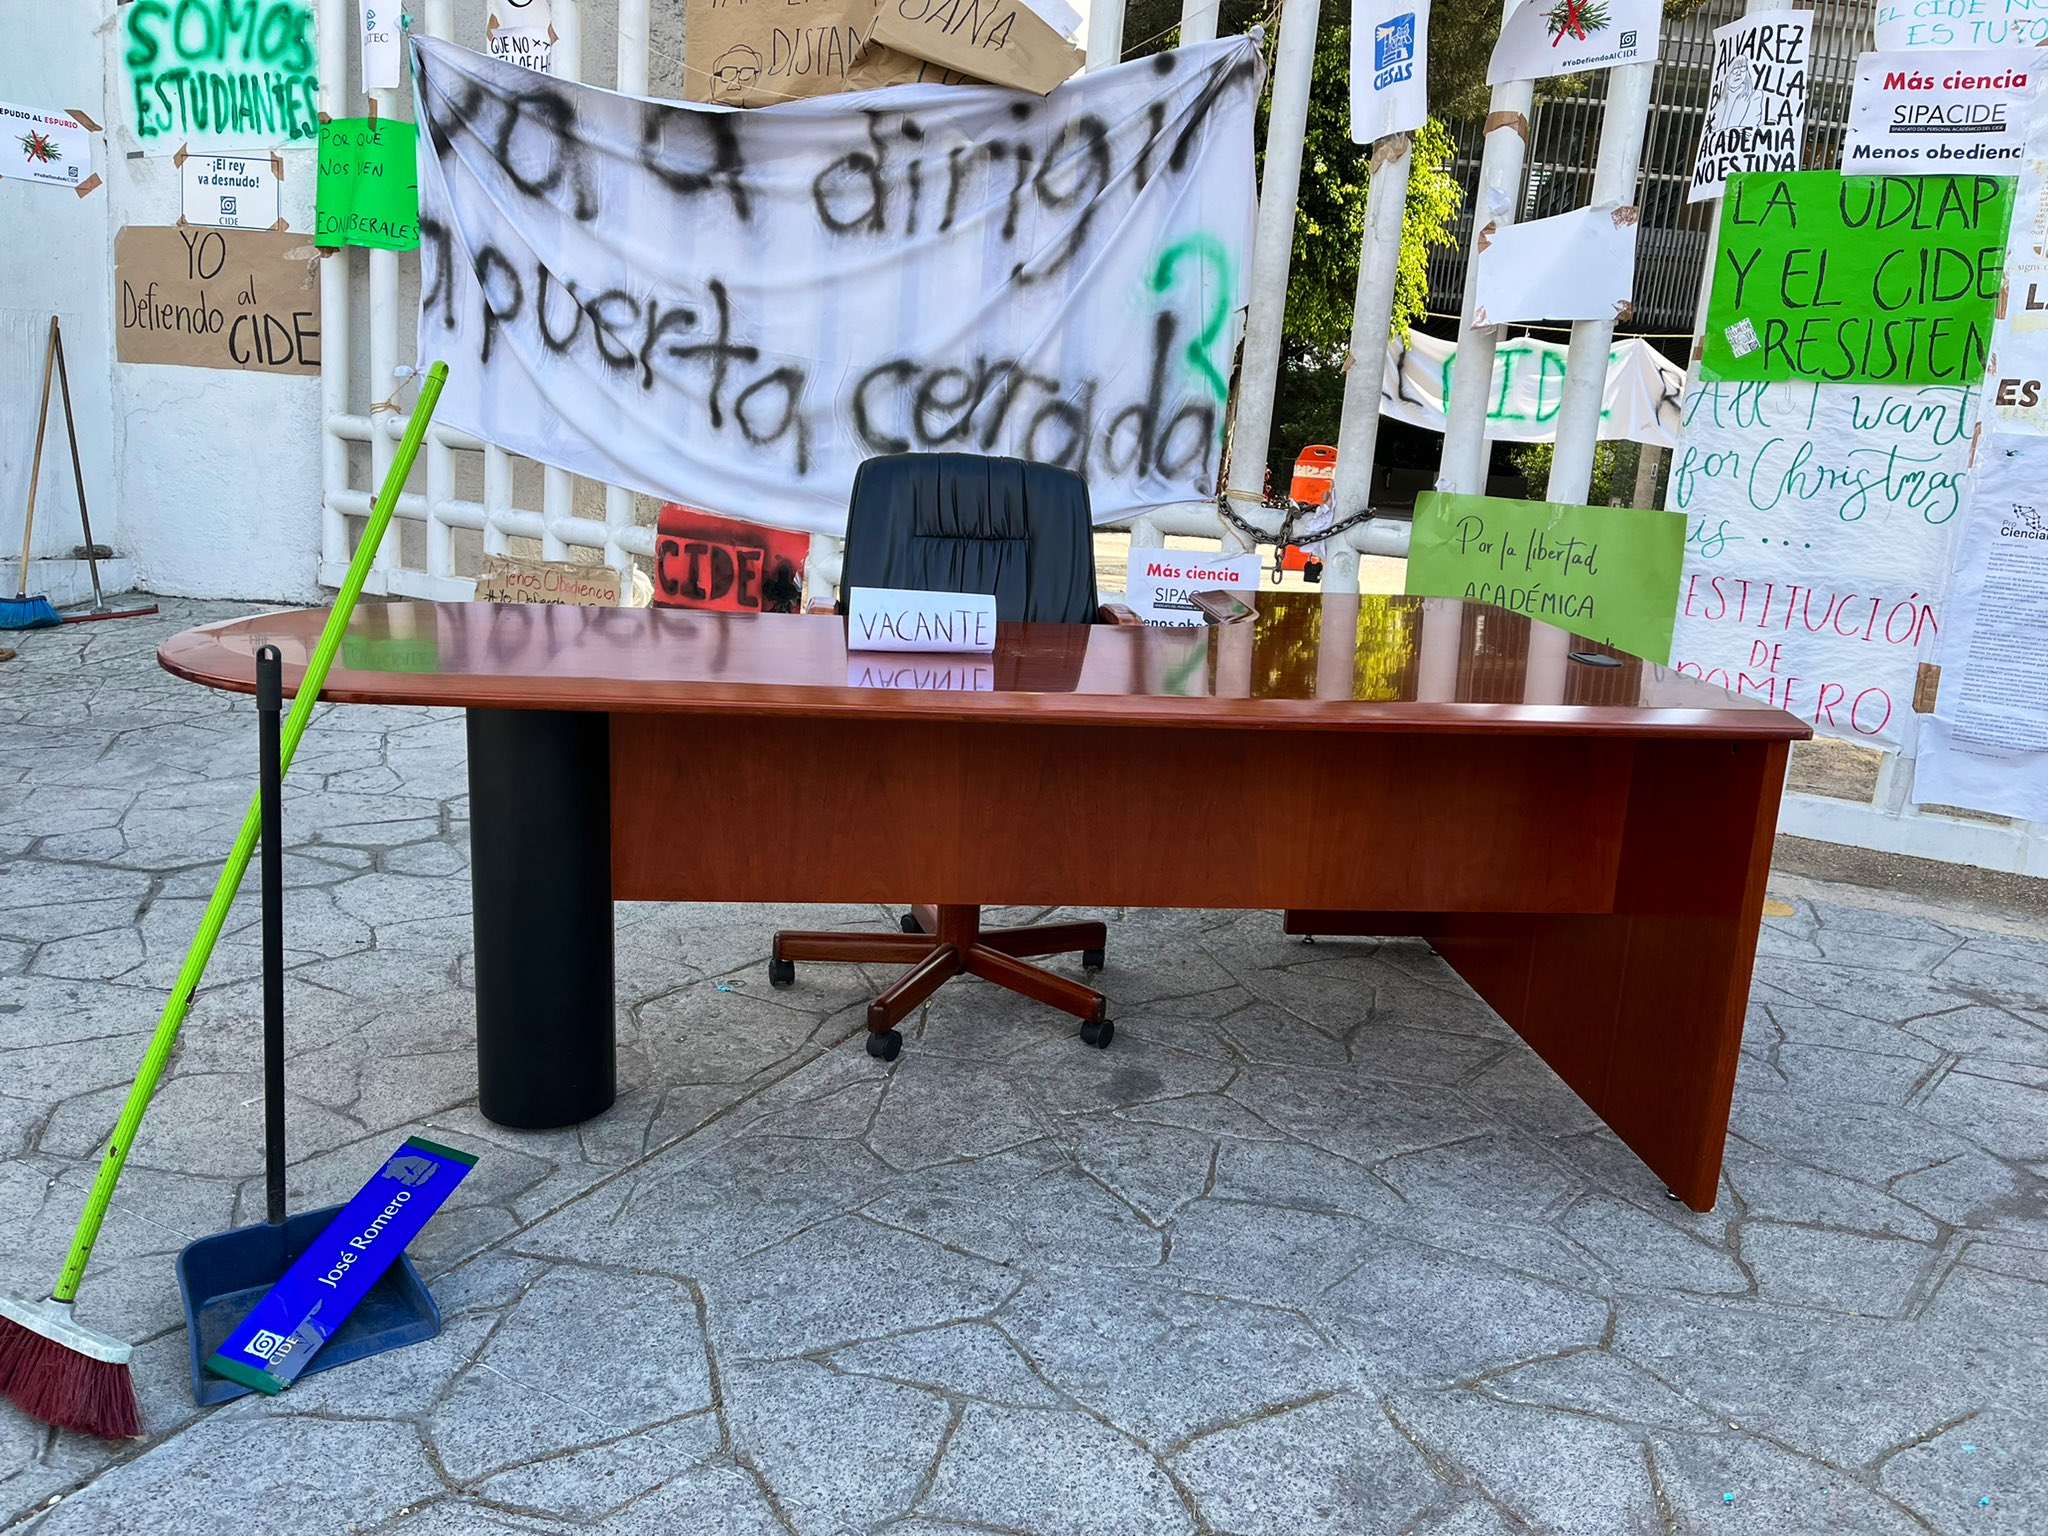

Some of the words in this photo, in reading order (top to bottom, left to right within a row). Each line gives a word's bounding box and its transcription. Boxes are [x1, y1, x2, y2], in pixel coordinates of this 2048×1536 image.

[1878, 7, 1905, 26] EL
[127, 0, 313, 72] SOMOS
[512, 36, 530, 54] NO
[1906, 23, 1955, 46] ES
[1883, 70, 1935, 91] Más
[1946, 68, 2028, 91] ciencia
[32, 114, 43, 122] AL
[44, 116, 79, 129] ESPURIO
[1893, 103, 2008, 124] SIPACIDE
[320, 127, 350, 147] POR
[1698, 127, 1796, 162] ACADEMIA
[1852, 145, 1919, 160] Menos
[198, 175, 209, 185] va
[211, 173, 260, 189] desnudo!
[229, 161, 246, 175] rey
[320, 158, 350, 177] NOS
[1733, 180, 1797, 228] LA
[1840, 175, 1999, 230] UDLAP
[218, 216, 239, 226] CIDE
[180, 230, 226, 280] YO
[237, 274, 257, 306] al
[1726, 247, 1762, 311] Y
[1780, 247, 1842, 309] EL
[1872, 247, 2005, 311] CIDE
[123, 279, 225, 334] Defiendo
[2025, 282, 2048, 311] L
[228, 311, 321, 366] CIDE
[475, 243, 810, 478] puerta
[1995, 378, 2042, 408] ES
[1851, 386, 1982, 446] want
[1675, 446, 1738, 509] for
[1748, 438, 1970, 525] Christmas
[1687, 514, 1745, 559] is
[2000, 526, 2048, 541] Ciencia
[2002, 519, 2017, 528] Pro
[1456, 515, 1494, 555] Por
[1500, 532, 1517, 571] la
[1526, 528, 1599, 576] libertad
[543, 569, 616, 601] Obediencia
[657, 539, 763, 608] CIDE
[1147, 563, 1181, 578] Más
[1186, 565, 1240, 582] ciencia
[1465, 582, 1594, 619] ACADÉMICA
[859, 611, 989, 645] VACANTE
[1749, 639, 1784, 673] DE
[318, 1250, 358, 1289] José
[349, 1190, 411, 1251] Romero
[269, 1334, 299, 1366] CIDE
